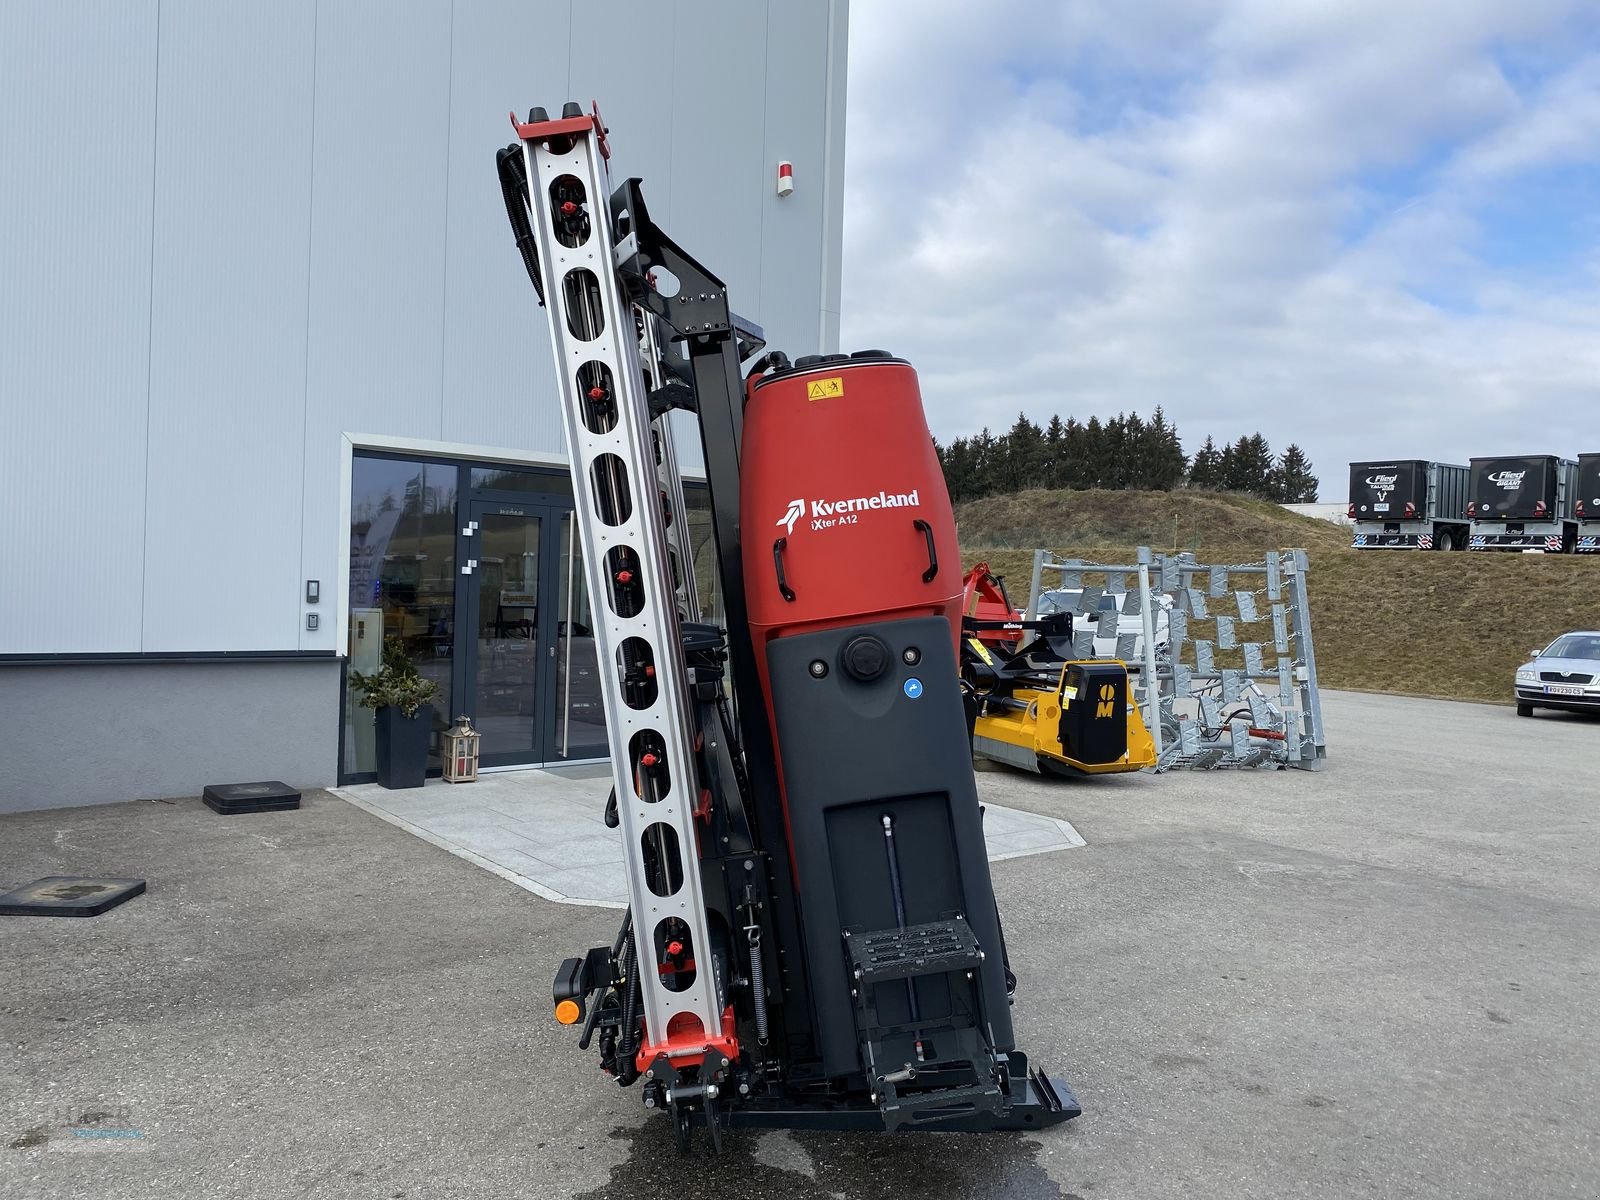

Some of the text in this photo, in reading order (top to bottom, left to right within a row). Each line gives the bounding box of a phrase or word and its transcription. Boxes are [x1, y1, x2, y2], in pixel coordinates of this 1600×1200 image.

[1375, 474, 1398, 485] Fliegl
[1499, 470, 1526, 481] Fliegl
[811, 489, 920, 518] Kverneland
[811, 514, 858, 531] iXter A12
